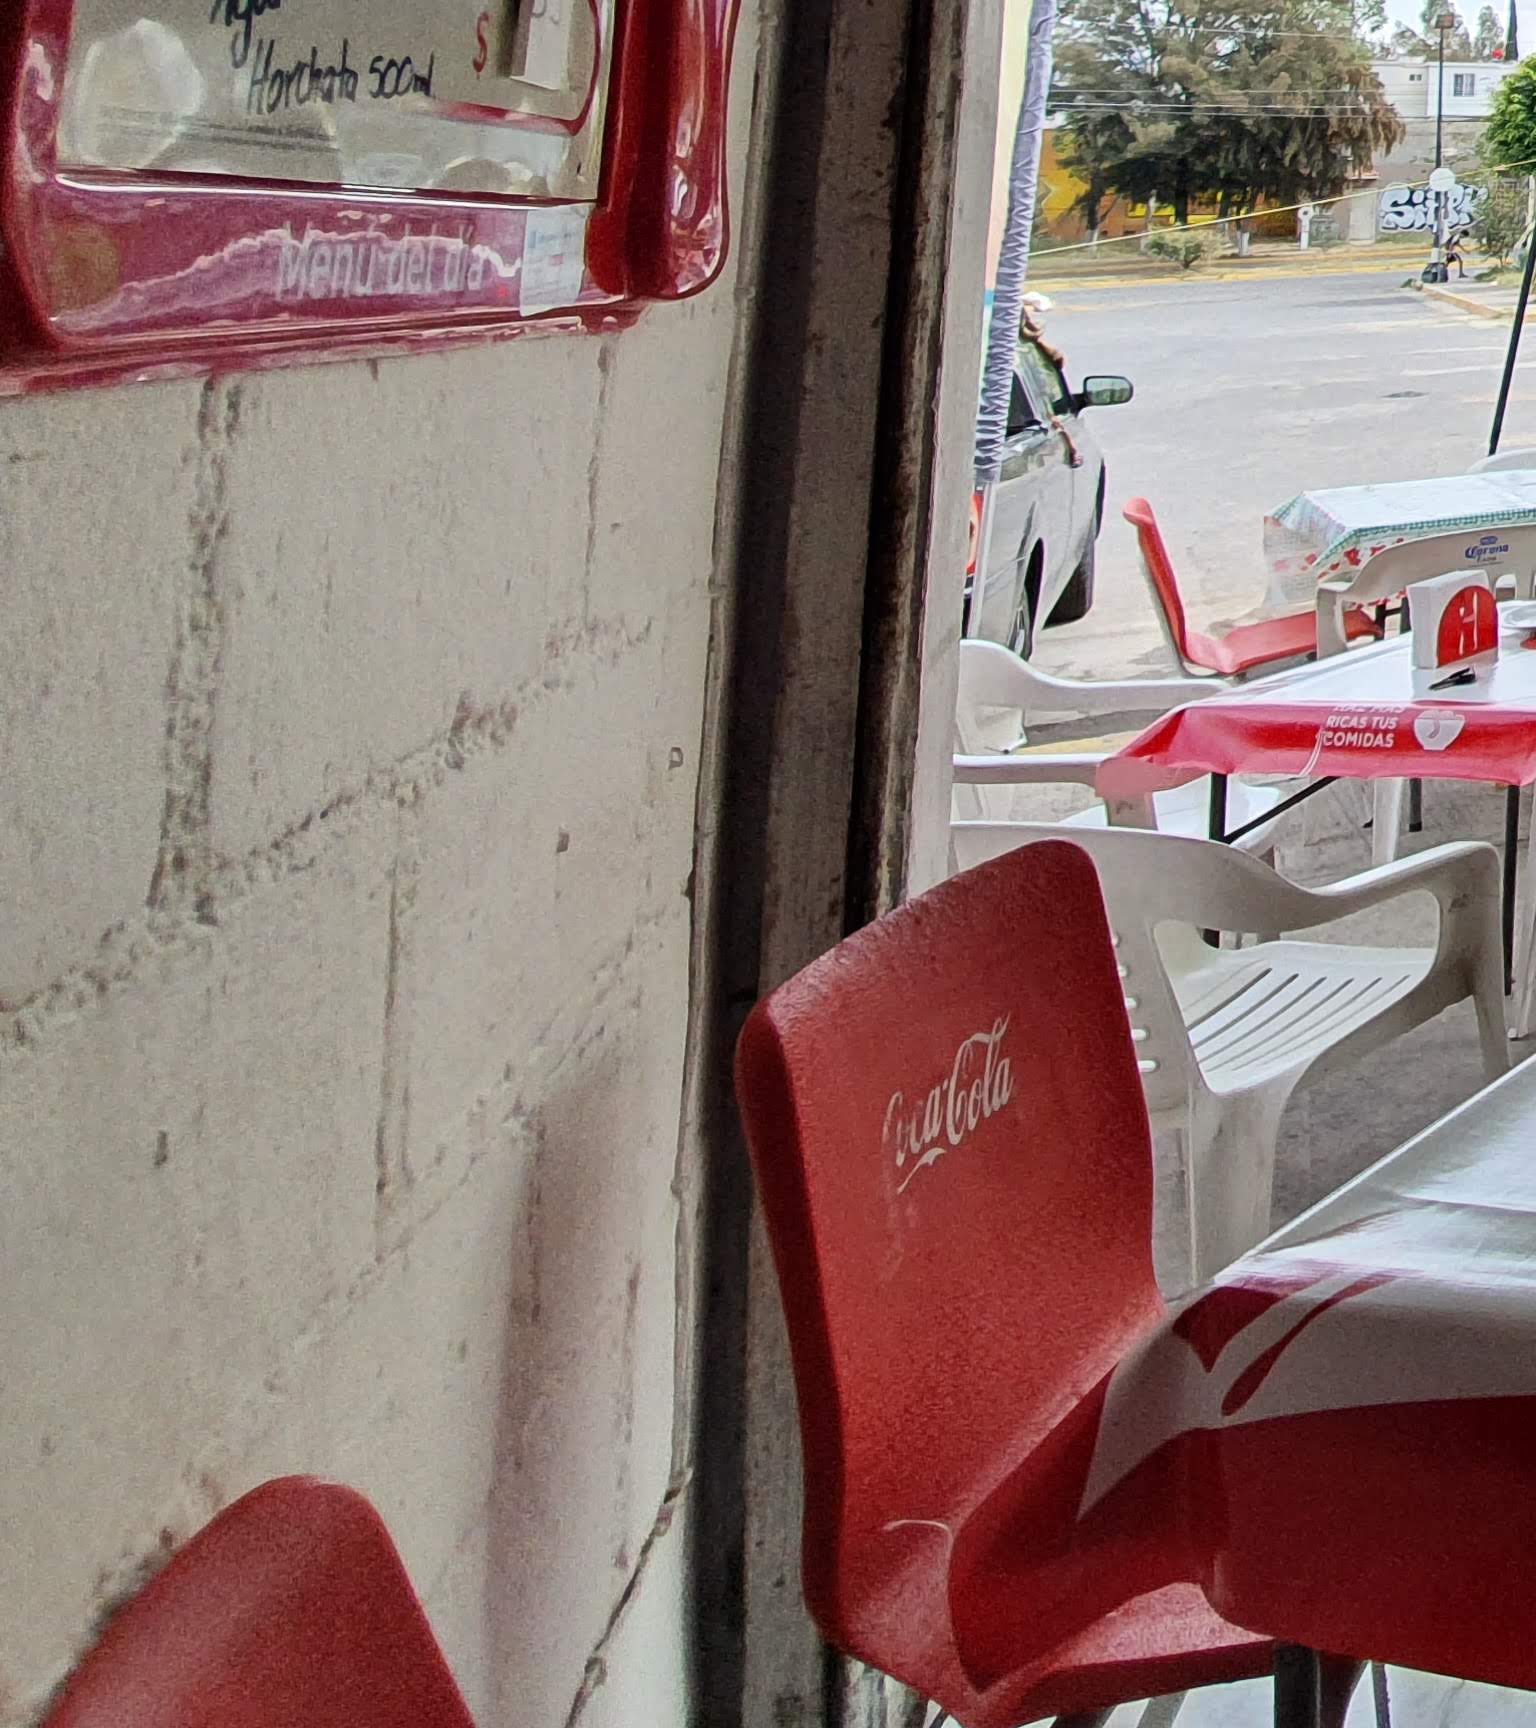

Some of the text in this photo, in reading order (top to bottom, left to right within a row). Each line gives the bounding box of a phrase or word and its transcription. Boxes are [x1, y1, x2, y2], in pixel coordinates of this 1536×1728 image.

[248, 38, 359, 115] Horchata
[1326, 715, 1399, 729] RICAS TUS
[1322, 731, 1395, 748] COMIDAS
